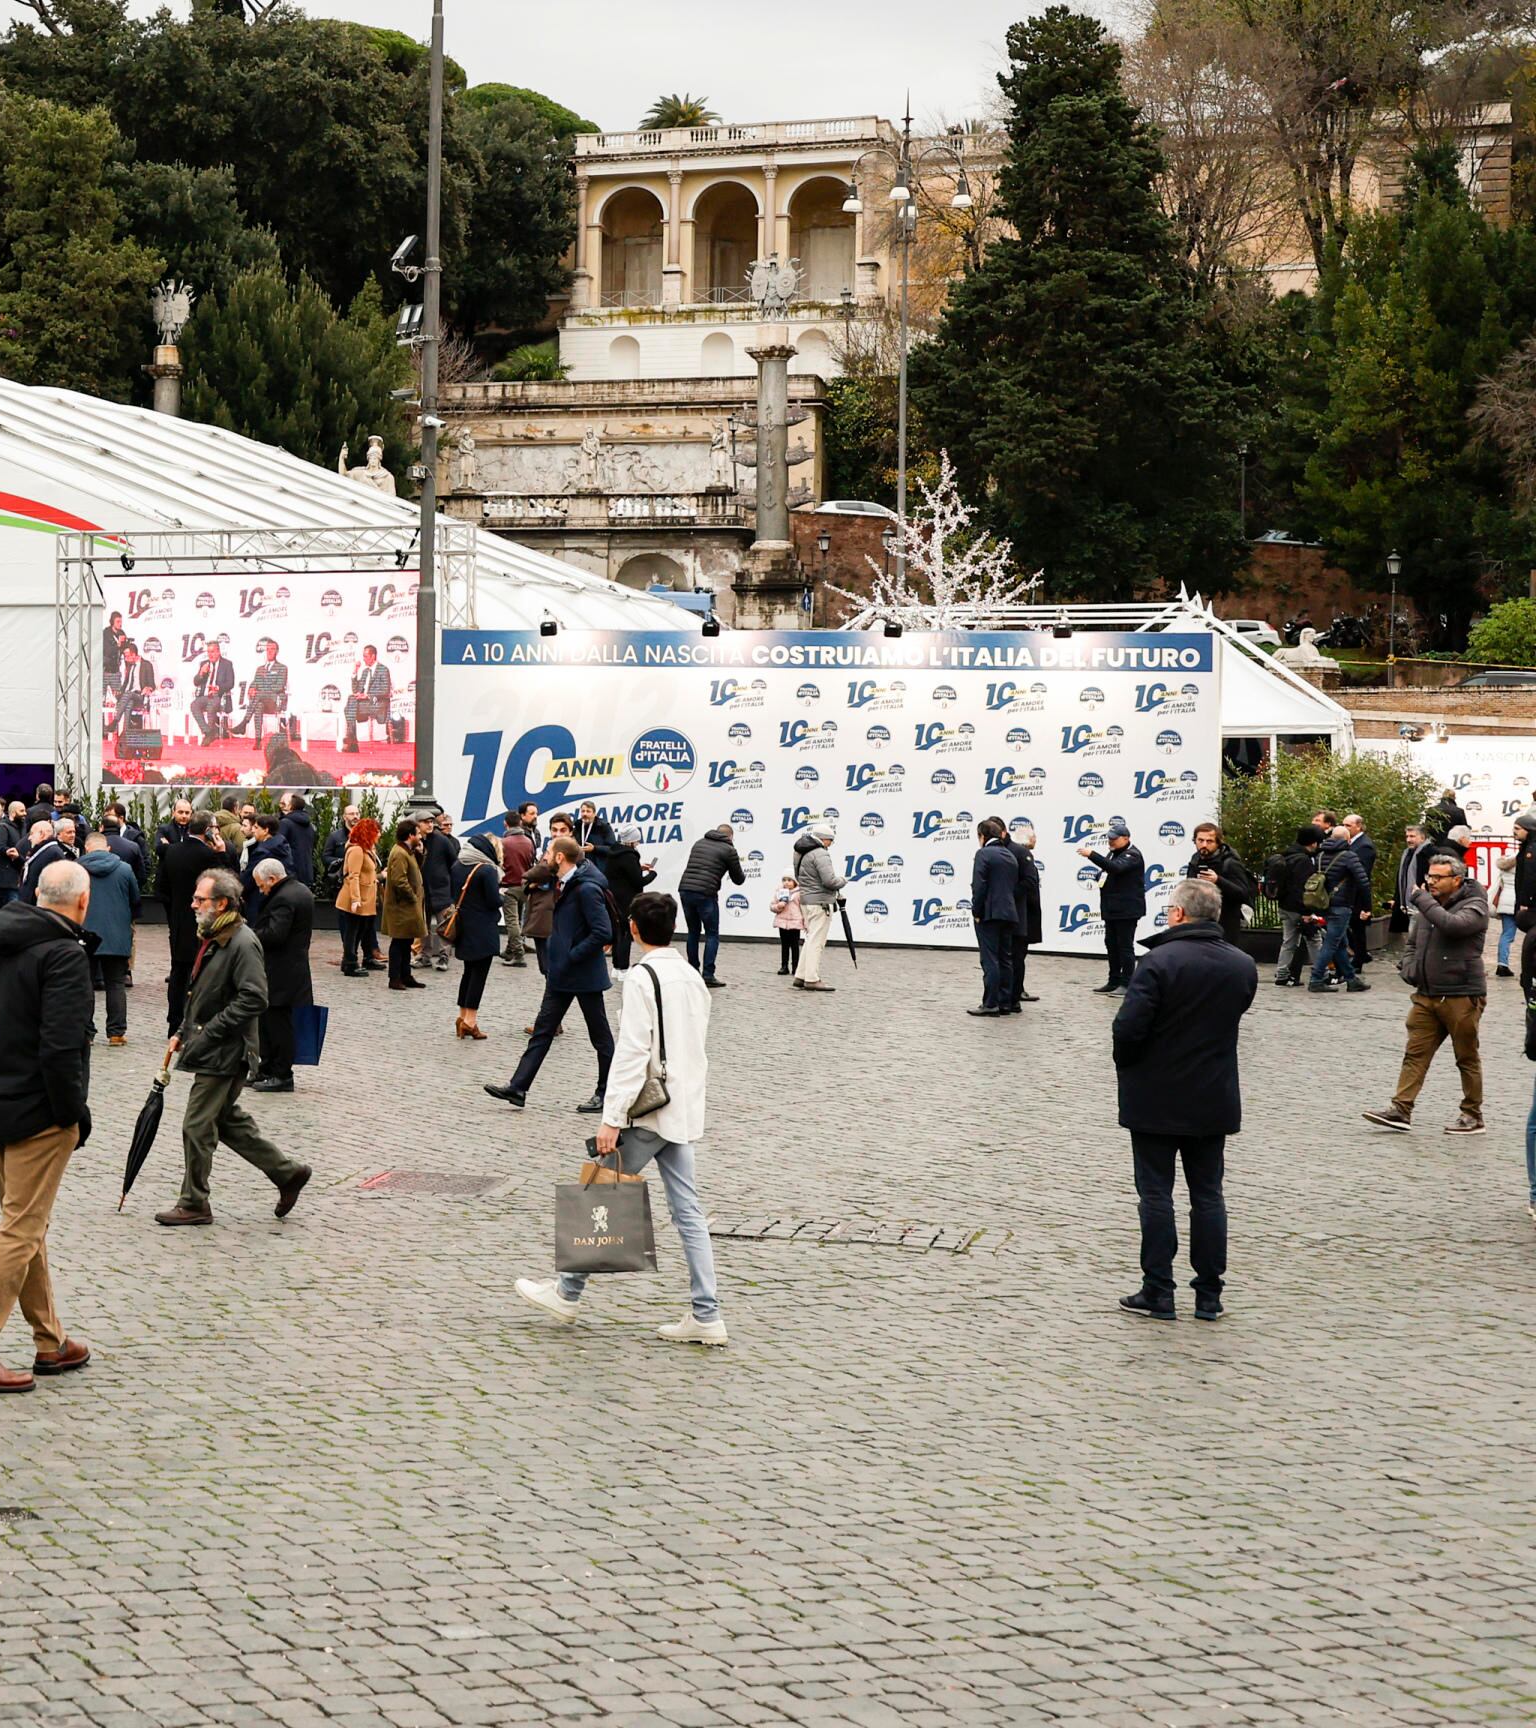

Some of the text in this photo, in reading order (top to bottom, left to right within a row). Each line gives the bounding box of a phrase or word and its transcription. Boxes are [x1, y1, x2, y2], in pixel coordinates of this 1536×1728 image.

[462, 644, 476, 661] A
[483, 643, 504, 662] 10
[511, 644, 563, 662] ANNI
[571, 645, 637, 663] DALLA
[751, 646, 924, 665] COSTRUIAMO
[929, 647, 1034, 667] L'ITALIA
[1040, 648, 1086, 667] DEL
[1091, 648, 1201, 668] FUTURO
[710, 678, 738, 706] 10
[847, 680, 877, 708] 10
[986, 681, 1017, 710] 10
[1135, 683, 1167, 712] 10
[639, 740, 686, 750] FRATELLI
[780, 720, 808, 747] 10
[915, 722, 945, 750] 10
[1061, 724, 1092, 753] 10
[635, 750, 691, 763] d'ITALIA
[460, 724, 614, 837] 10 ANNI
[709, 760, 737, 787] 10
[846, 763, 876, 791] 10
[985, 766, 1015, 795] 10
[1134, 769, 1166, 798] 10
[597, 802, 684, 824] AMORE
[781, 806, 810, 834] 10
[913, 810, 943, 838] 10
[1063, 814, 1094, 843] 10
[845, 854, 874, 882] 10
[912, 897, 942, 926] 10
[1059, 903, 1090, 932] 10
[574, 1237, 595, 1245] DAN
